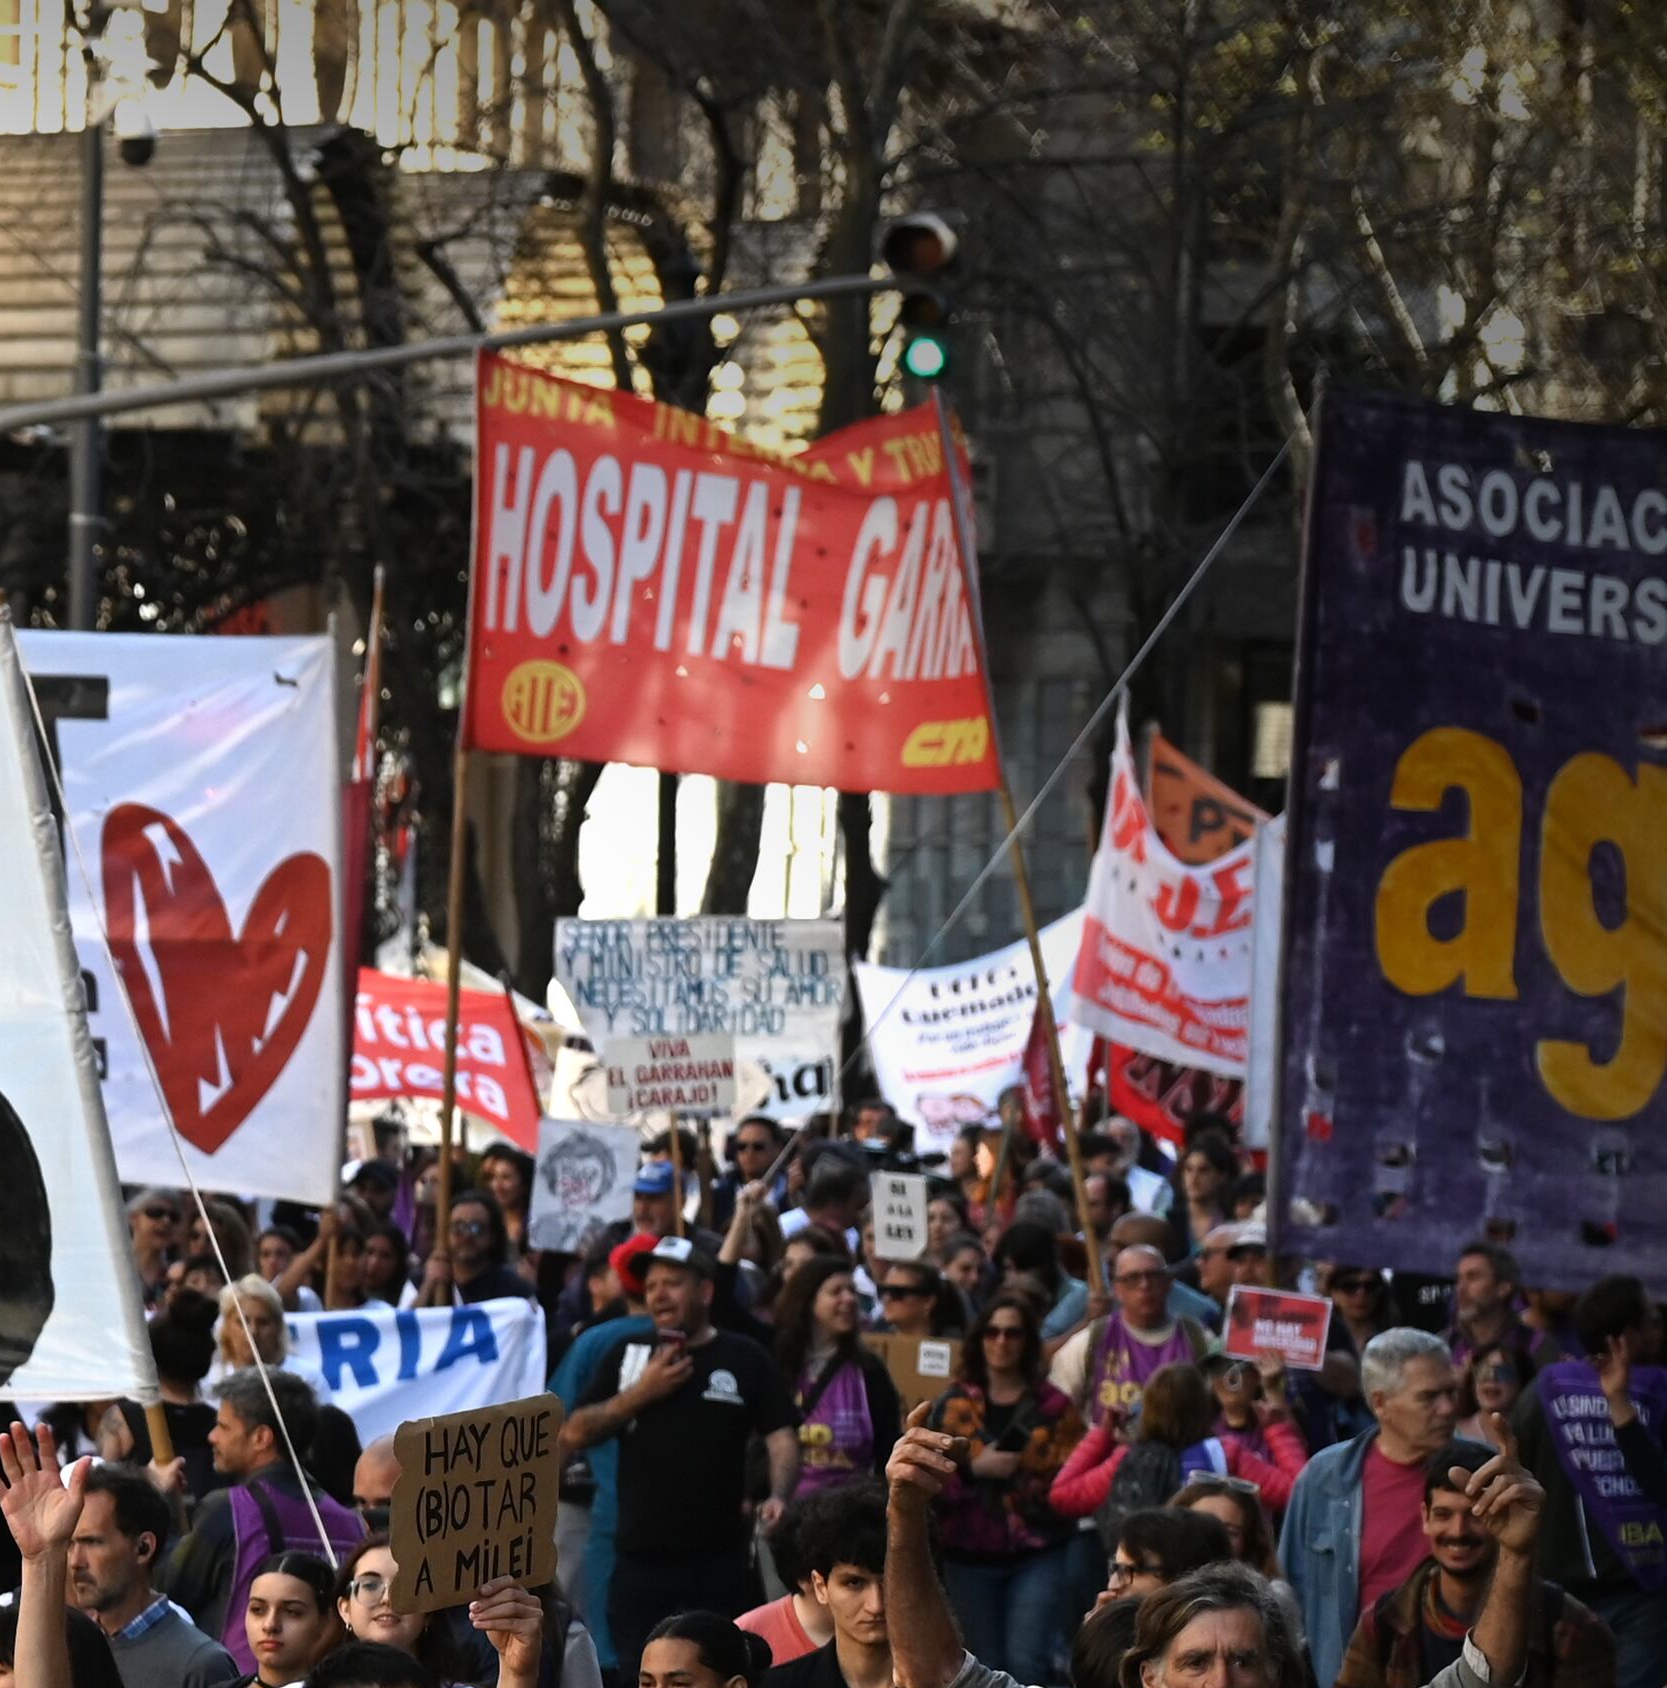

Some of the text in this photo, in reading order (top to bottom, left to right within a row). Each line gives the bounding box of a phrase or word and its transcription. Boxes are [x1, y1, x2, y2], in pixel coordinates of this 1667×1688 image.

[484, 365, 616, 430] JUNTA
[485, 441, 802, 673] HOSPITAL
[508, 675, 571, 734] ATE
[714, 948, 742, 977] DE
[759, 948, 830, 977] SALUD
[785, 979, 843, 1006] AMOR
[604, 1004, 620, 1031] Y
[649, 1038, 691, 1059] VIVA
[608, 1059, 735, 1088] EL GARRAHAN
[289, 1309, 499, 1391] RIA
[425, 1411, 551, 1476] HAY QUE
[416, 1471, 537, 1545] (B)OTAR
[415, 1556, 434, 1596] A
